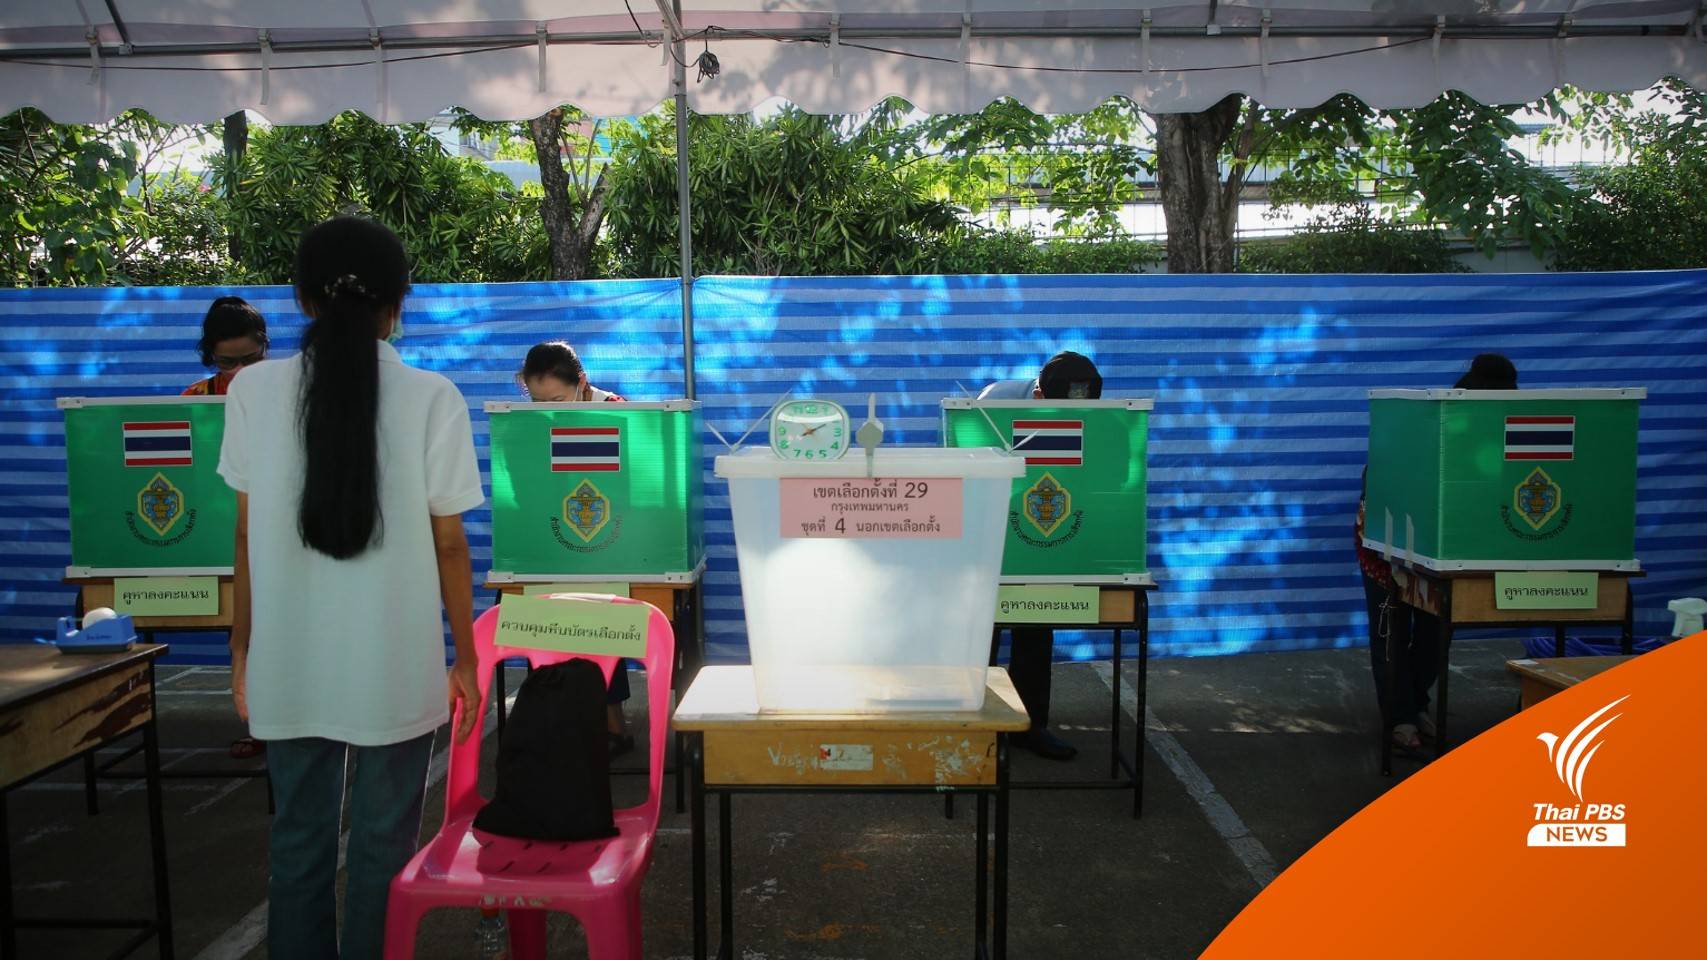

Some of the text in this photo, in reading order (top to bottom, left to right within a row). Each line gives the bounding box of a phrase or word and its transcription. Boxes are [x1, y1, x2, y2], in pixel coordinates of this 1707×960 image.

[830, 441, 839, 449] 4
[793, 449, 801, 457] 7
[805, 450, 814, 459] 6
[819, 450, 827, 458] 5
[813, 477, 929, 499] เขตเลือกตั้งที่ 29
[831, 502, 909, 516] กรุงเทพมหานคร
[801, 515, 941, 536] ชุดที่ 4 นอกเขตเลือกตั้ง
[122, 590, 209, 605] คูหาลงคะแนน
[1504, 587, 1589, 600] คูหาลงคะแนน
[1000, 600, 1089, 614] คูหาลงคะแนน
[501, 620, 641, 641] ควบคุมหีบบัตรเลือกตั้ง
